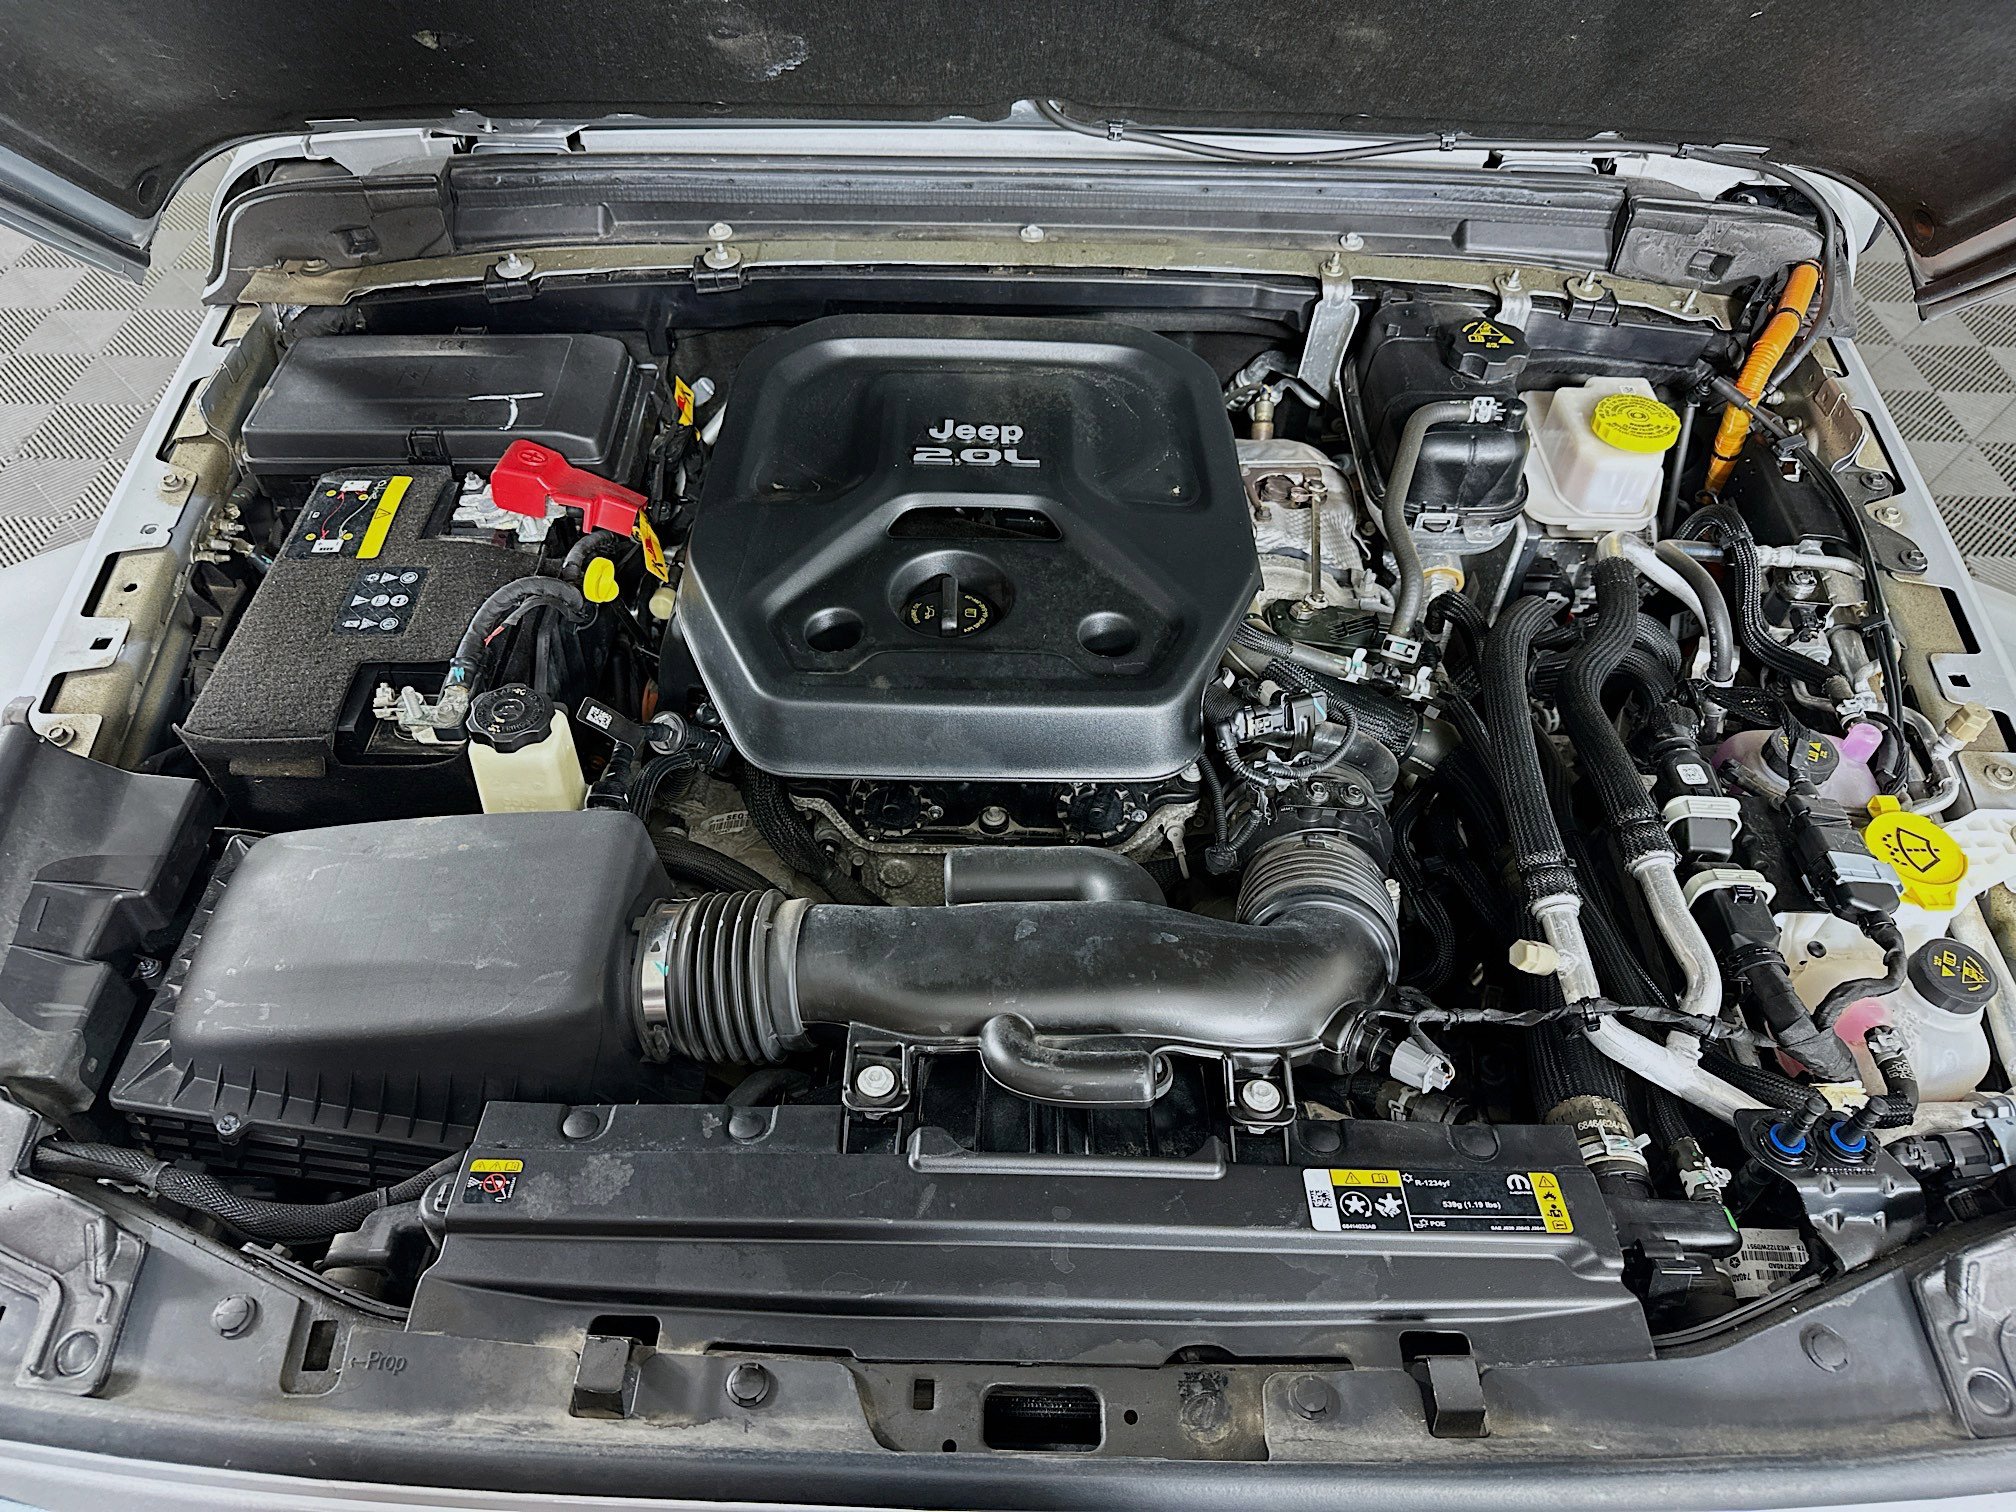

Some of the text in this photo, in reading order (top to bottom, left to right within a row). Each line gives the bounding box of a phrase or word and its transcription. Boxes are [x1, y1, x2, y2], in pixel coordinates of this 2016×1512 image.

[928, 419, 1023, 447] Jeep
[913, 447, 1041, 468] 2.0L
[1414, 1179, 1451, 1188] R-1234yf
[365, 1350, 407, 1375] Prop
